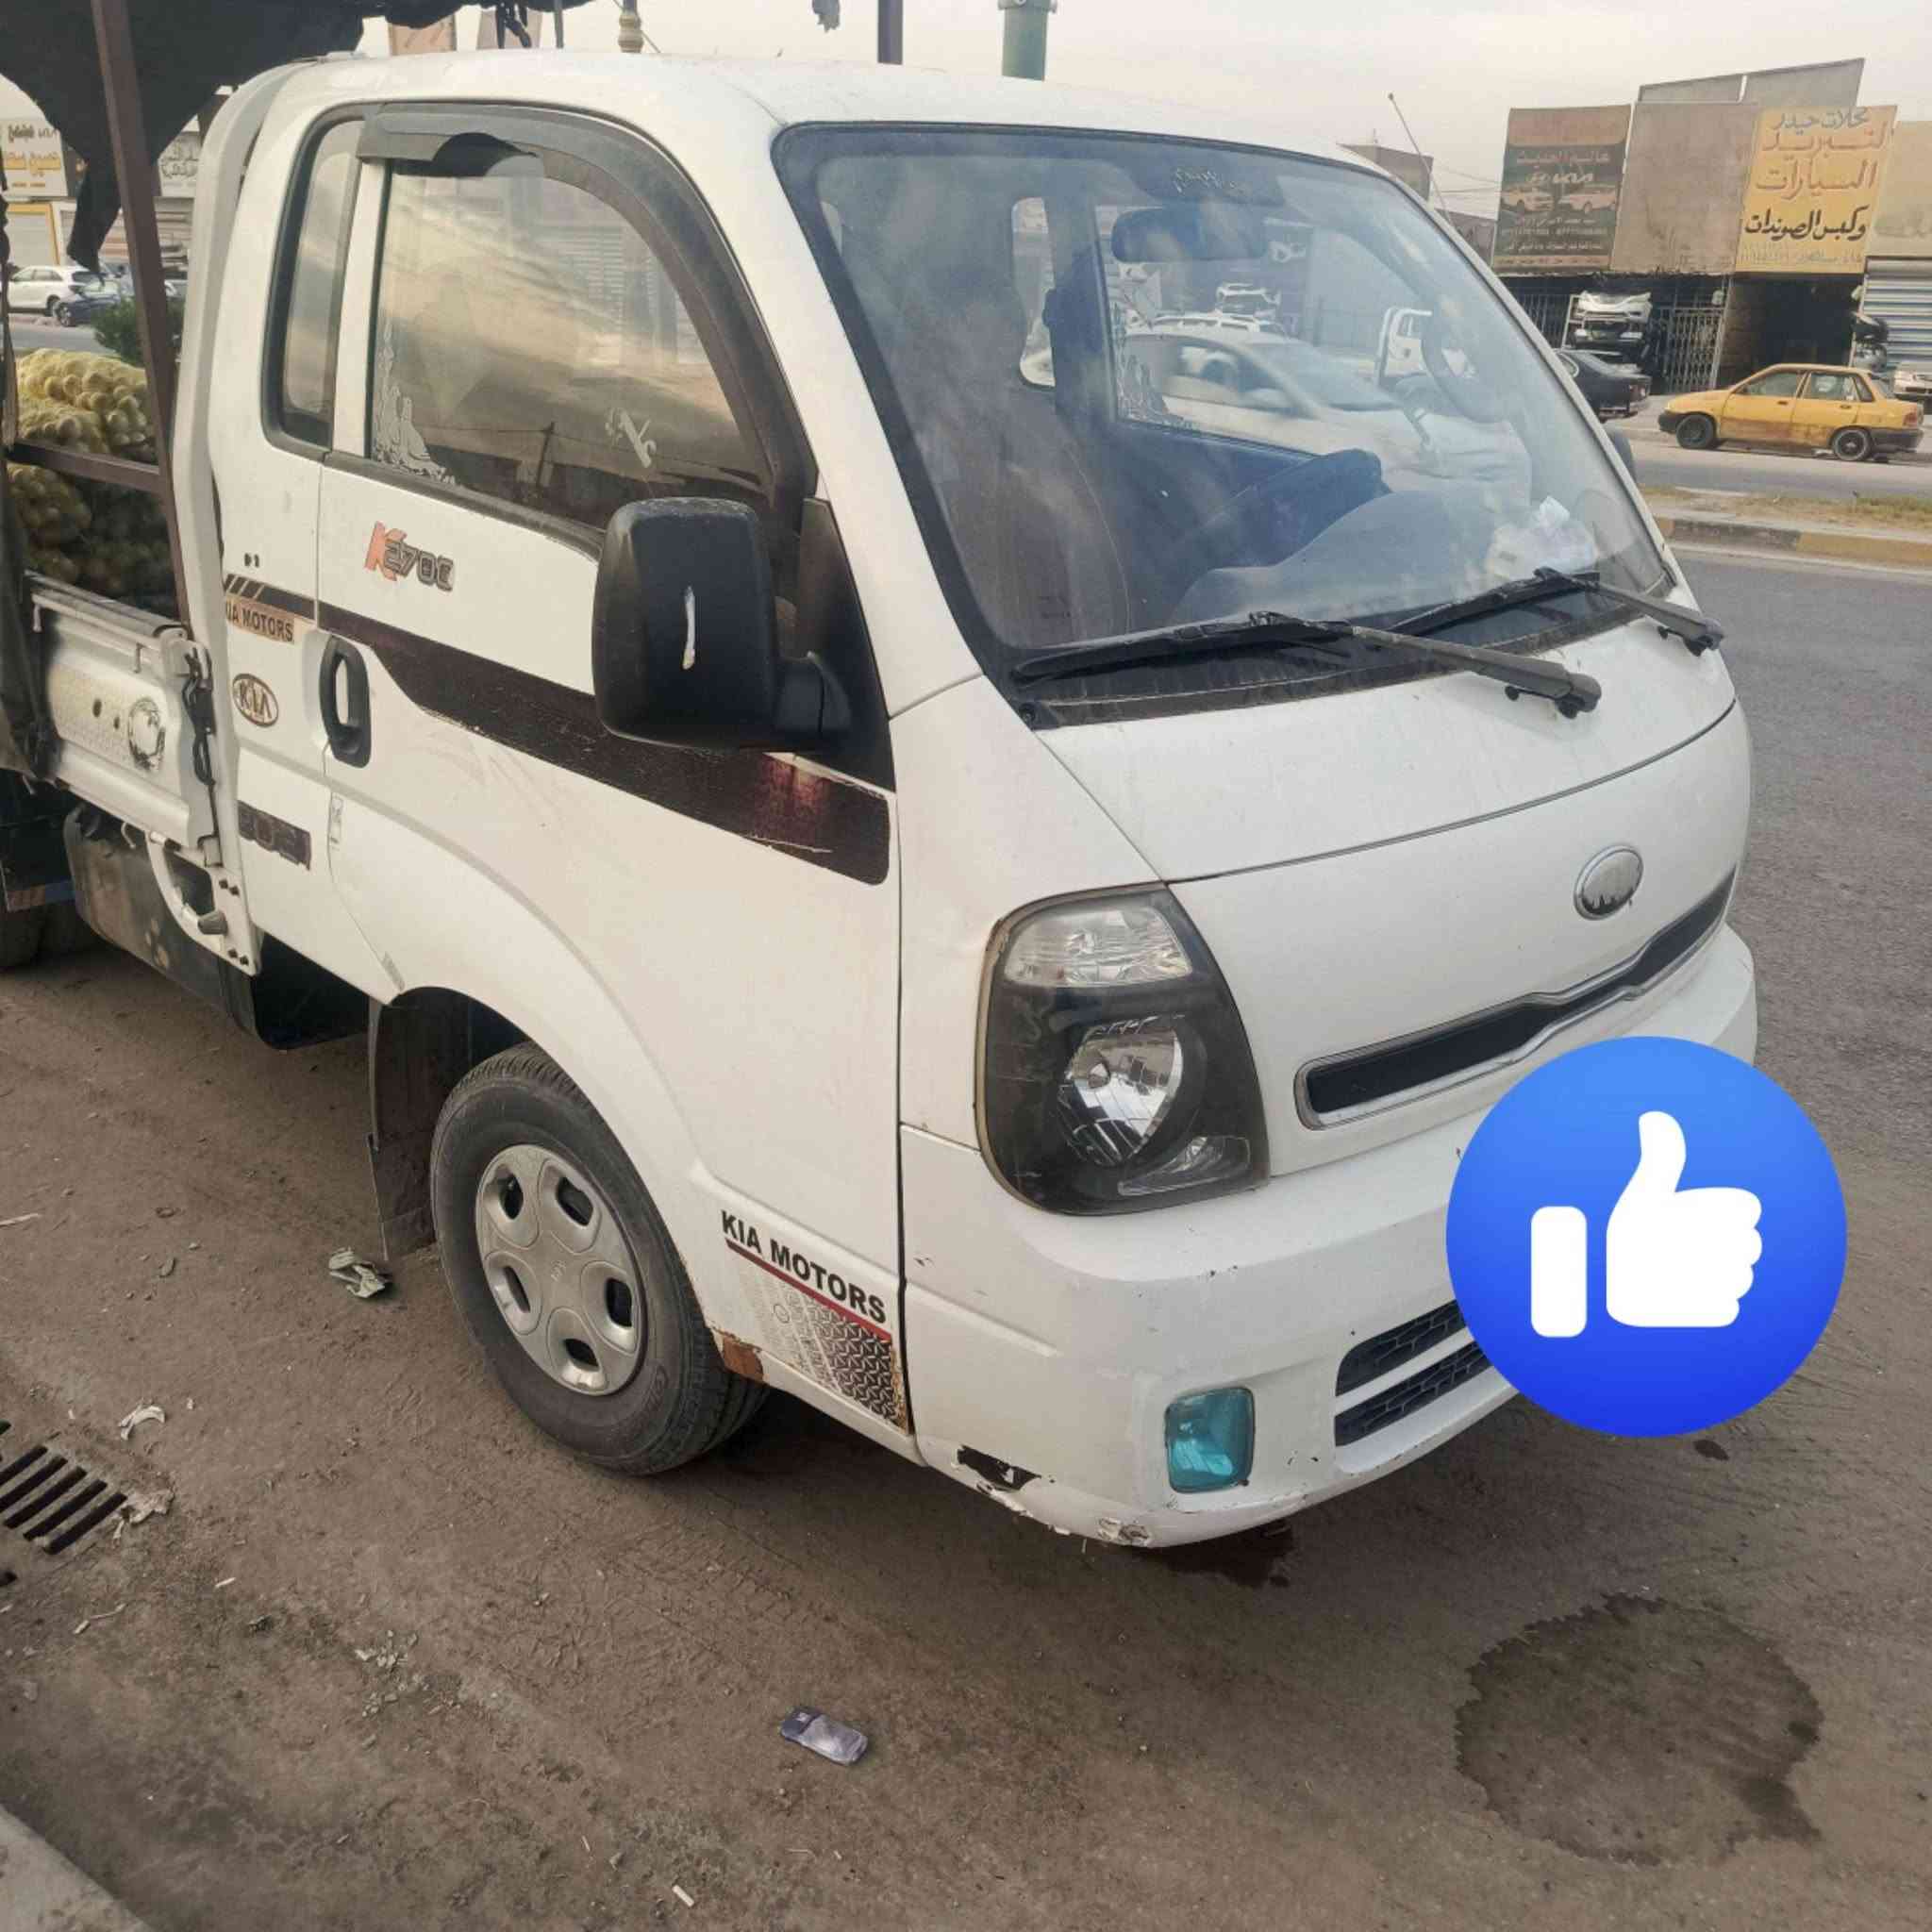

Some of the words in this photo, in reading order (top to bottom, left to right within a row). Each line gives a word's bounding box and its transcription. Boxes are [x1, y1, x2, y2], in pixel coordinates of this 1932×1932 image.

[1755, 158, 1878, 200] السيارات
[242, 608, 294, 642] MOTORS
[721, 1209, 762, 1254] KIA
[770, 1238, 888, 1324] MOTORS
